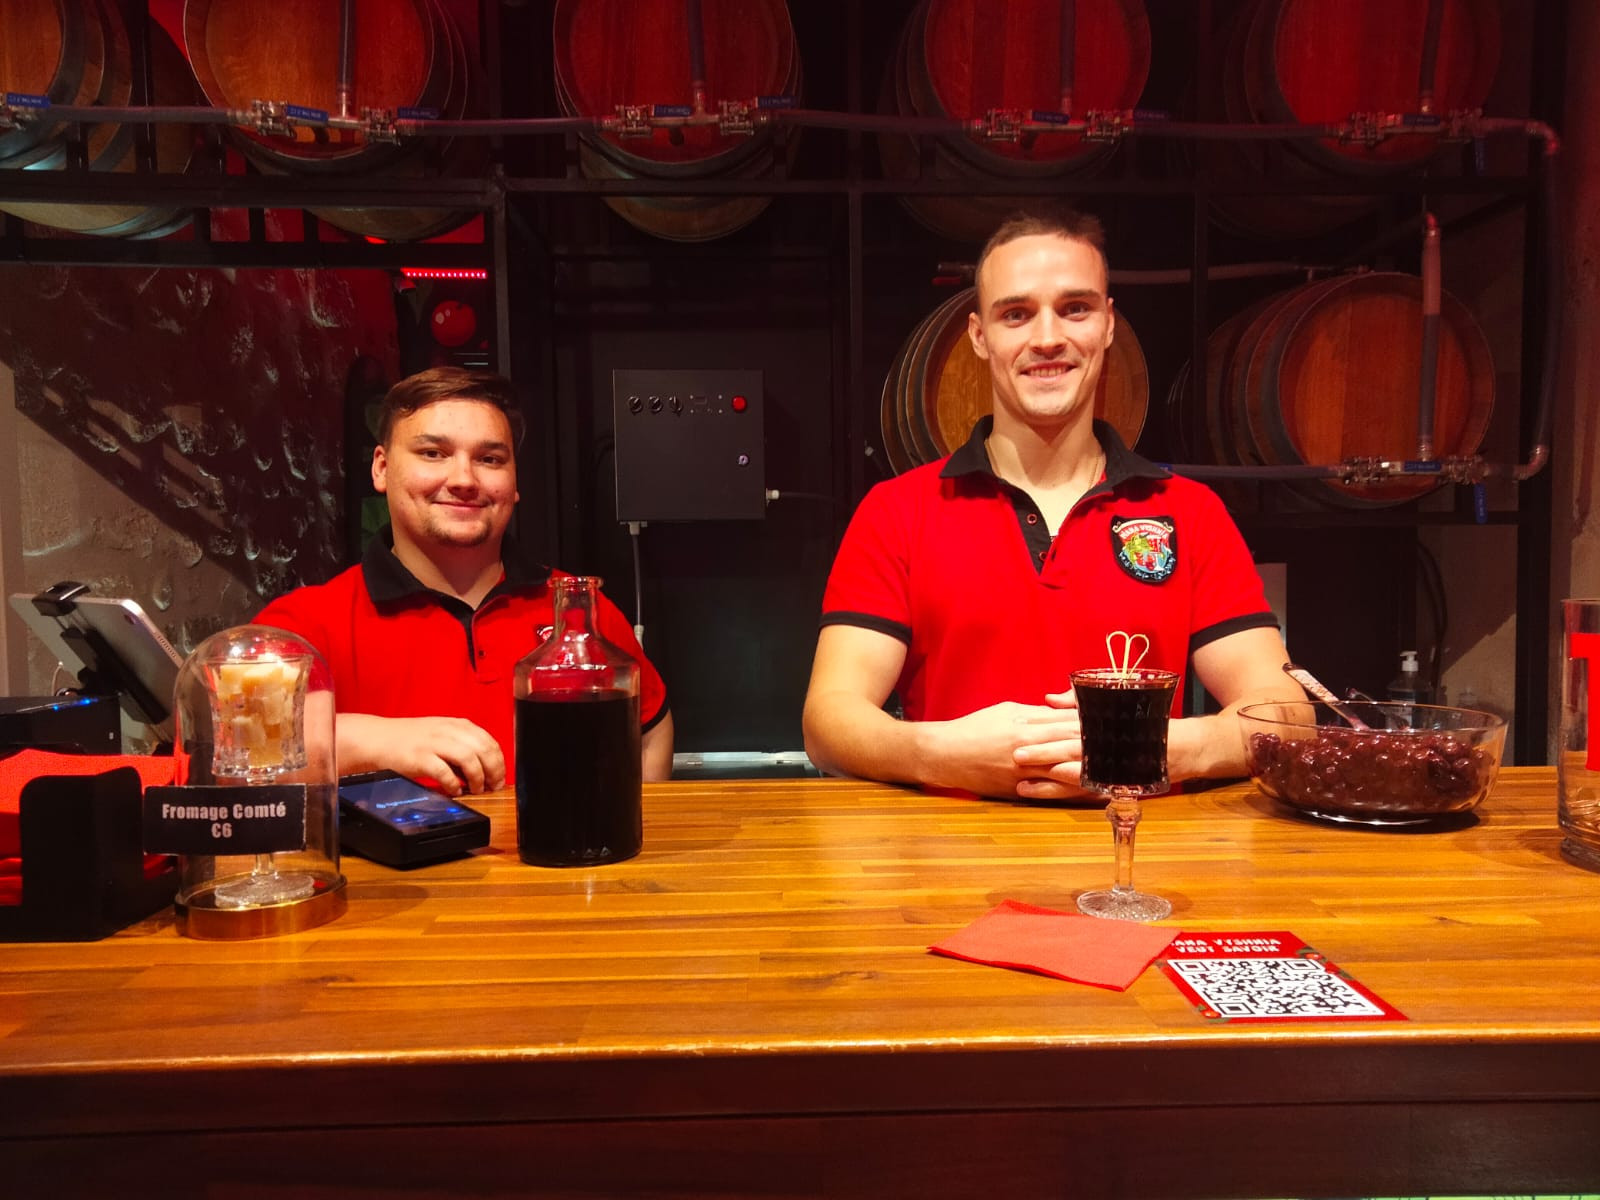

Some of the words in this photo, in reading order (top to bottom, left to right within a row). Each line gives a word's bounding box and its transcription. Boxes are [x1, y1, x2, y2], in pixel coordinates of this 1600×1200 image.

[162, 803, 228, 821] Fromage
[232, 801, 287, 818] Comté
[1212, 938, 1282, 946] VYSHNIA
[1222, 945, 1280, 953] SAVOIR
